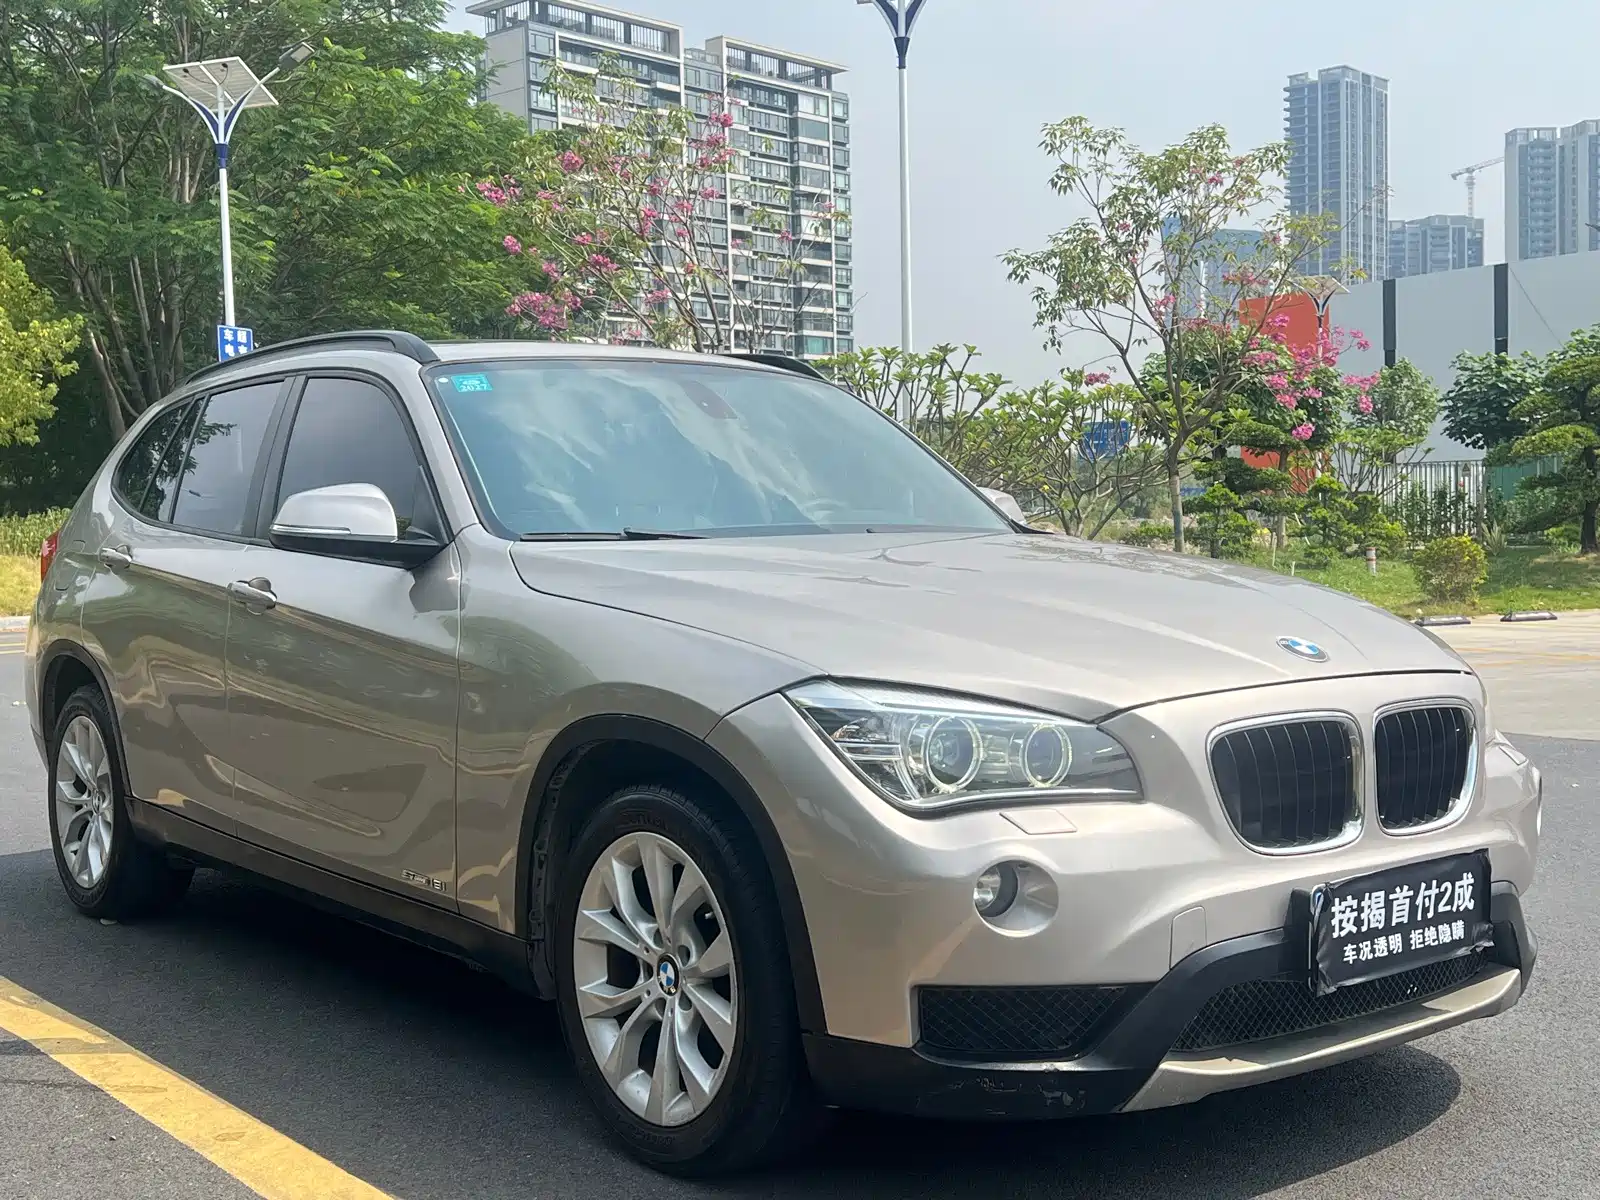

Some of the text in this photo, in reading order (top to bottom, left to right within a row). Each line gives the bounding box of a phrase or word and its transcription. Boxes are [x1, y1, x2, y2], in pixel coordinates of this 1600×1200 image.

[1331, 872, 1475, 939] 按揭首付2成
[1343, 920, 1465, 965] 车况透明 拒绝隐瞒
